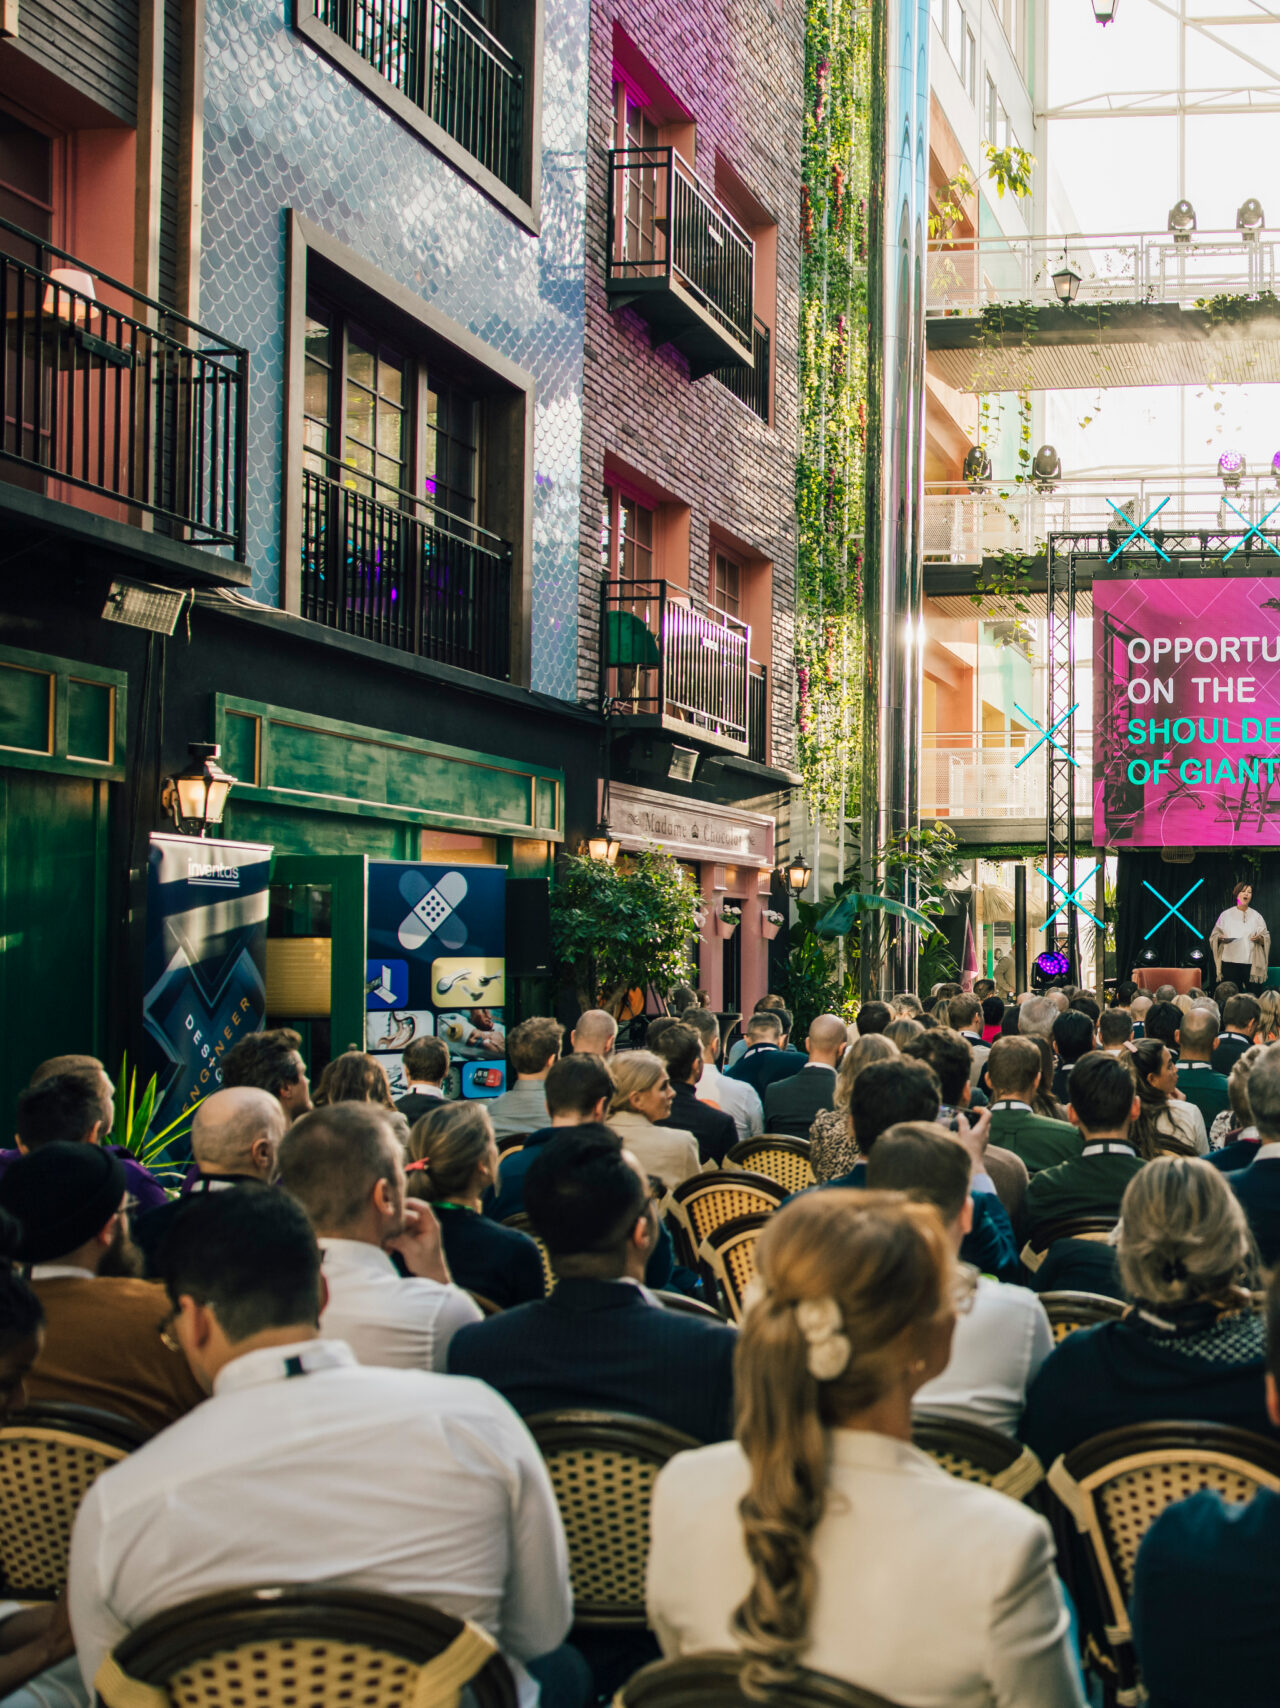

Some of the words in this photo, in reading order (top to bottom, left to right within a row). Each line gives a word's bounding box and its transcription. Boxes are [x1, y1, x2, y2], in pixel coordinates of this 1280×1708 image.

[1127, 677, 1174, 704] ON
[1191, 677, 1257, 704] THE
[1127, 758, 1170, 785] OF
[645, 812, 687, 838] Madame
[187, 857, 240, 879] inventas
